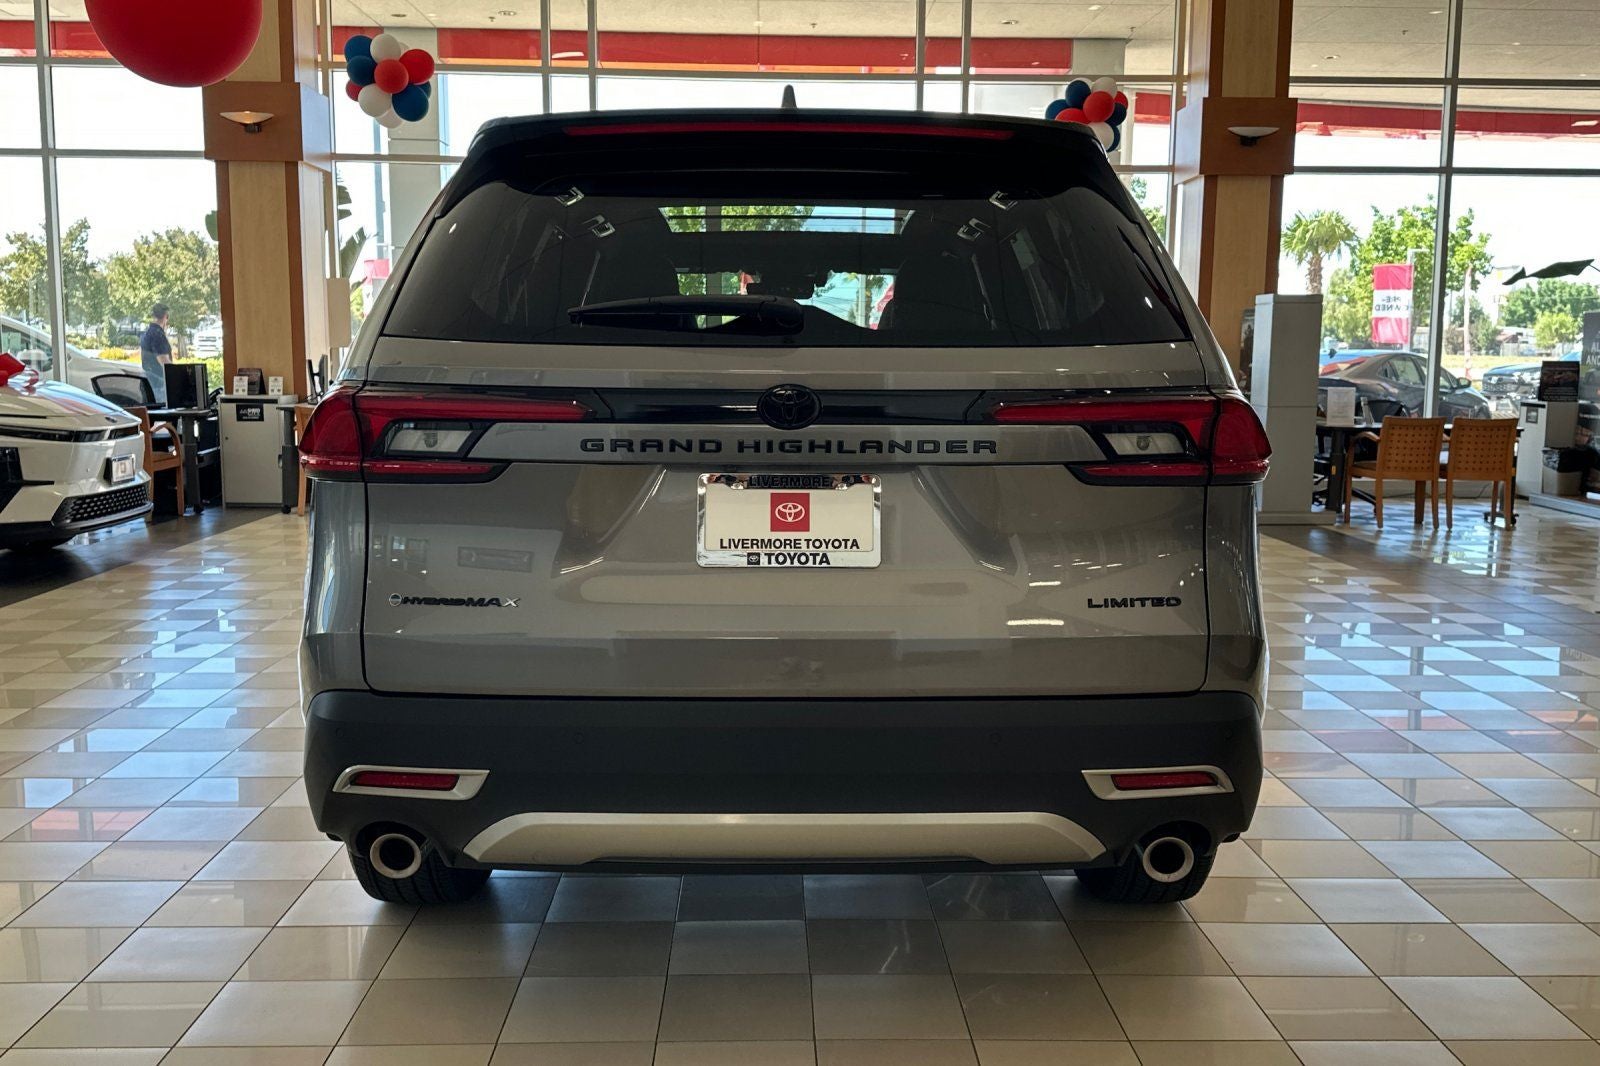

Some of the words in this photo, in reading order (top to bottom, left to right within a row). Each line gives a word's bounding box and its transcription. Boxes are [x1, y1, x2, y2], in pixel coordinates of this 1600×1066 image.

[580, 438, 723, 454] GRAND
[737, 439, 997, 455] HIGHLANDER
[750, 475, 831, 488] LIVERMORE
[719, 538, 802, 550] LIVERMORE
[804, 538, 860, 550] TOYOTA
[764, 552, 831, 566] TOYOTA
[1087, 596, 1182, 609] LIMITED
